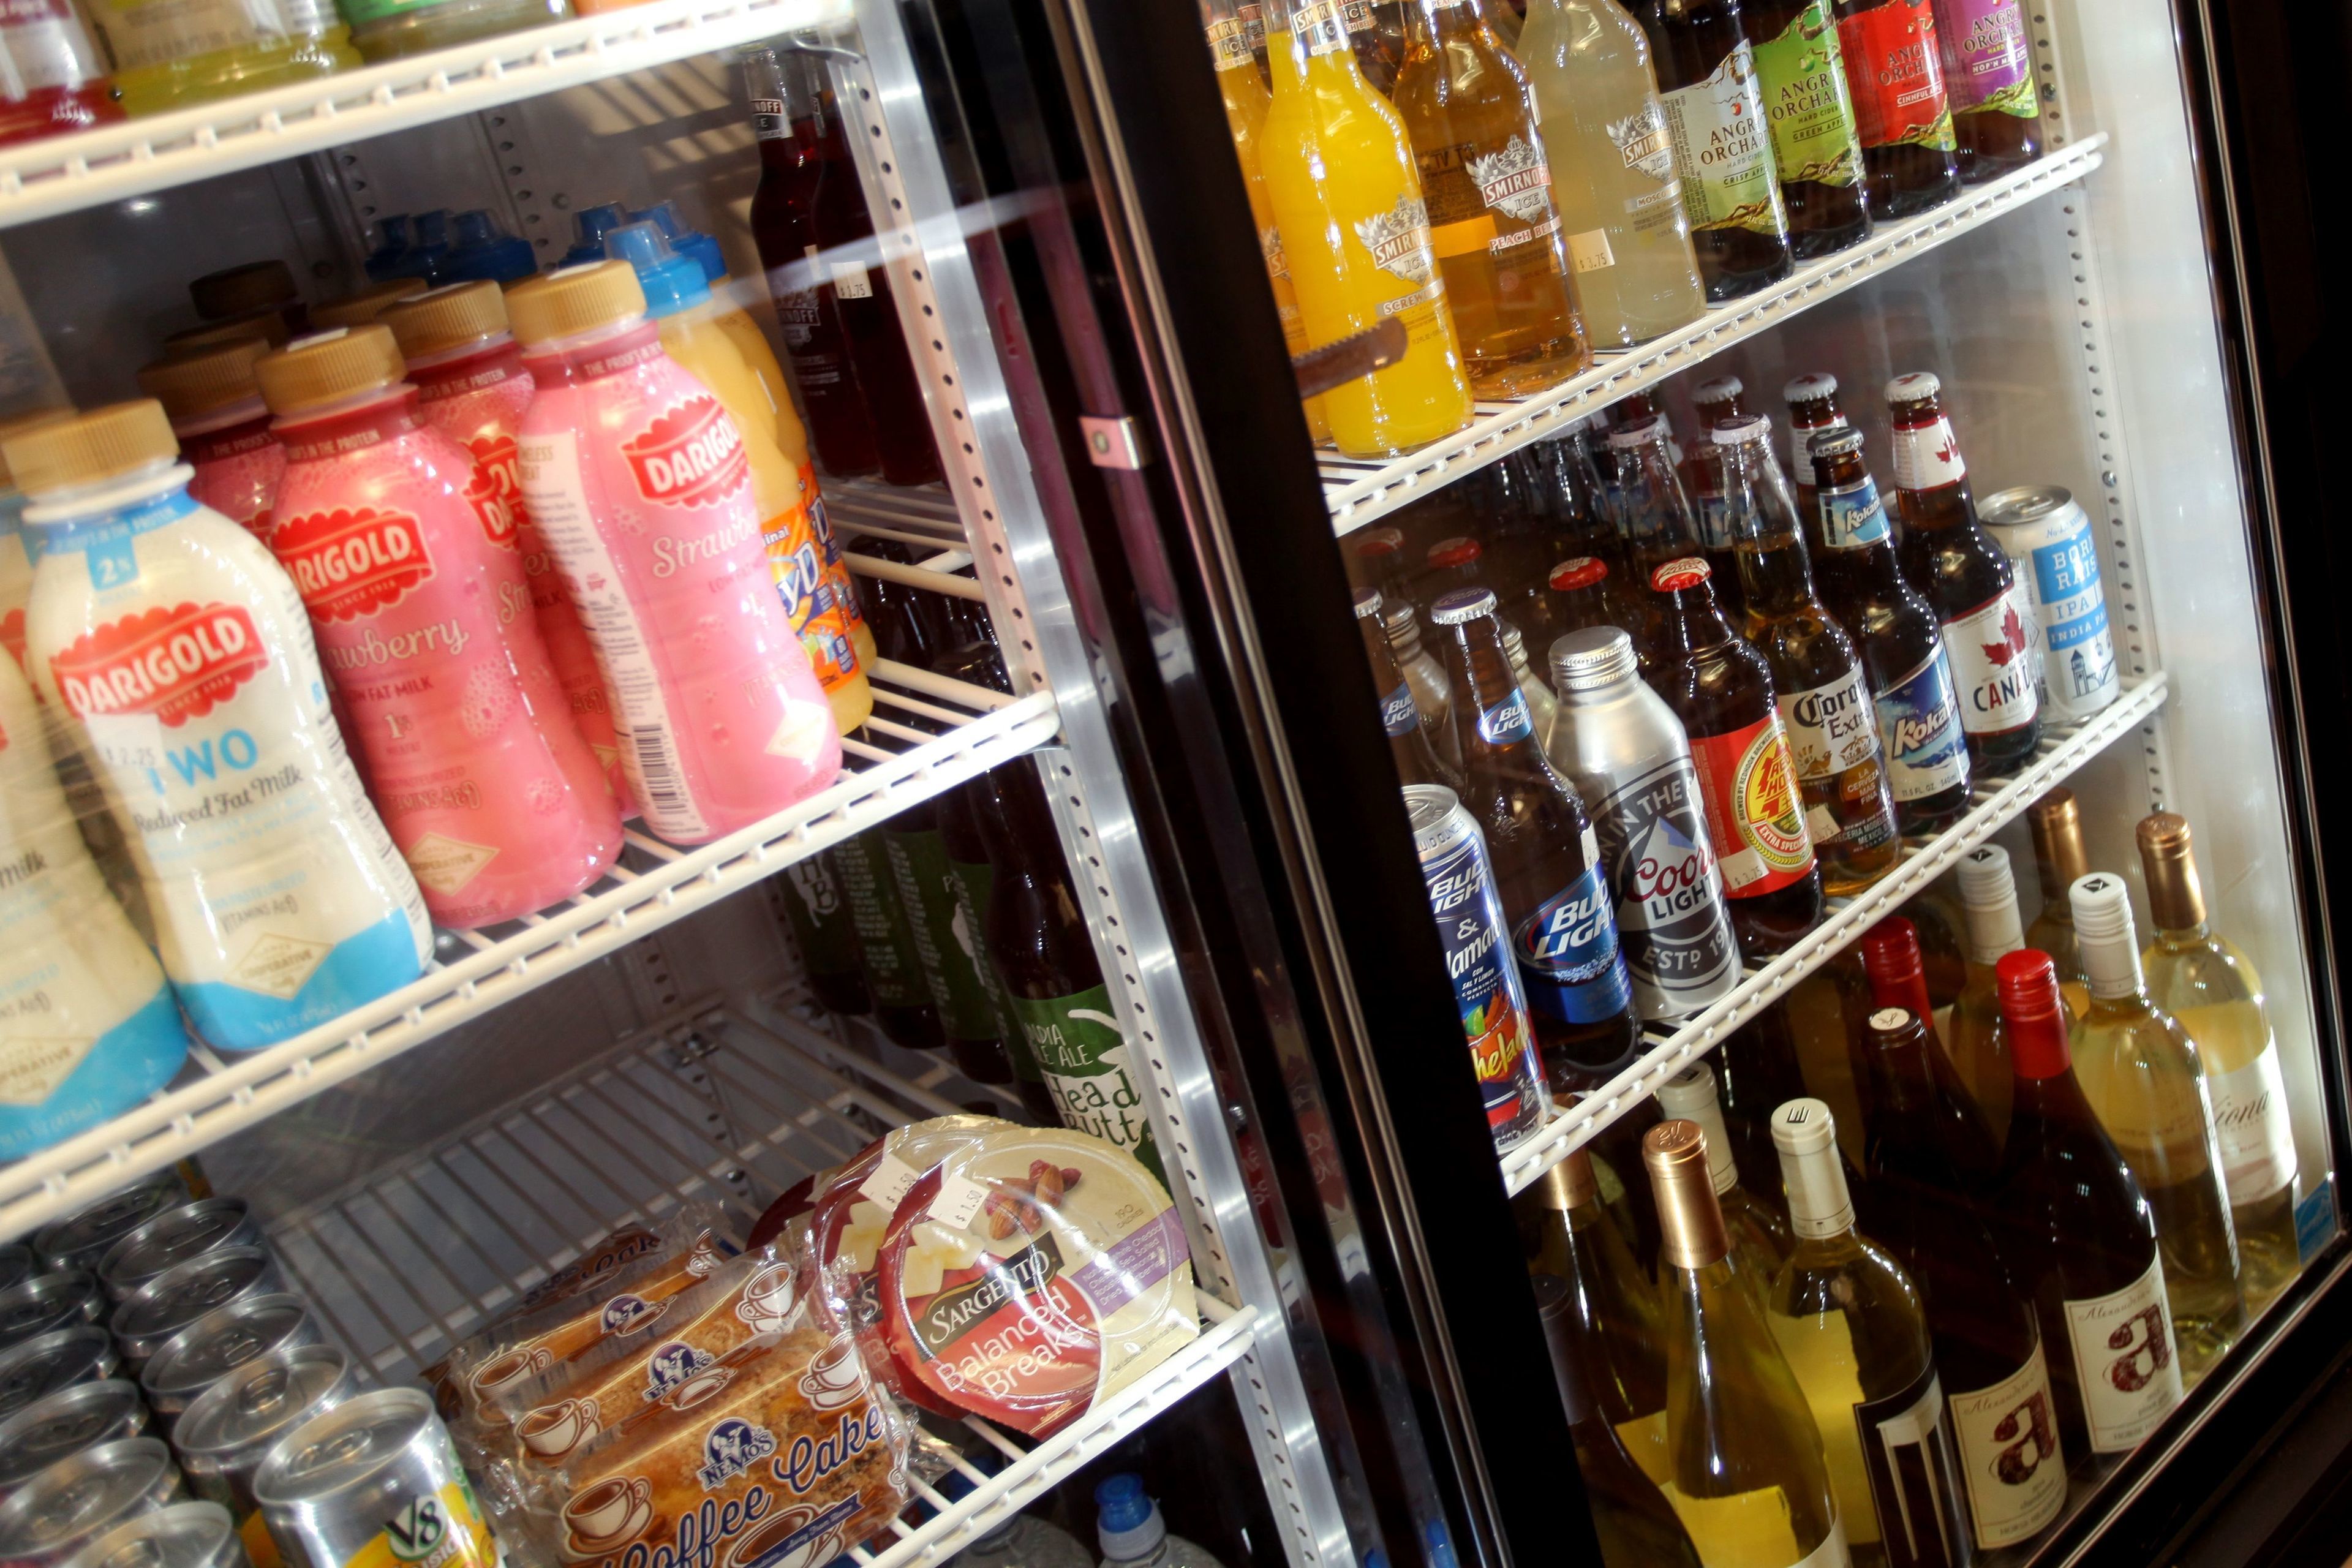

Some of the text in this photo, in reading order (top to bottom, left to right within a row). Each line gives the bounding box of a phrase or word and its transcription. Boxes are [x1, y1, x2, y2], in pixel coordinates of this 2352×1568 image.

[754, 100, 780, 113] NOFF
[1826, 118, 1845, 130] APPL
[1515, 192, 1541, 211] ICE
[1489, 230, 1531, 252] PEACH
[1586, 252, 1608, 269] 3.75
[283, 526, 411, 594] RIGOLD
[2056, 597, 2090, 620] IPA
[2051, 621, 2092, 643] INDIA
[63, 616, 246, 714] DARIGOLD
[396, 676, 433, 697] MILK
[1384, 704, 1415, 727] LIGH
[1500, 698, 1528, 721] BUD
[1847, 768, 1880, 793] CERVEZA
[134, 764, 303, 833] Reduced Fat Milk
[1608, 782, 1683, 837] IN THE
[1758, 825, 1781, 849] EXTRA
[1430, 858, 1486, 900] BUD
[1743, 865, 1764, 883] 3.75
[1433, 866, 1488, 914] IGHT
[1651, 875, 1714, 921] LIGHT
[1549, 876, 1610, 933] BUD
[1457, 918, 1480, 941] &
[1533, 900, 1615, 961] LIGHT
[1471, 965, 1485, 978] CON
[1058, 1044, 1094, 1068] ALE
[1044, 1068, 1141, 1114] Head
[955, 1189, 983, 1223] $ 1.50
[1114, 1204, 1134, 1219] 190
[929, 1250, 1050, 1346] SARGENTO
[936, 1286, 1072, 1393] Balanced
[980, 1321, 1084, 1401] Breaks
[773, 1405, 887, 1494] Cake
[384, 1493, 444, 1550] V8
